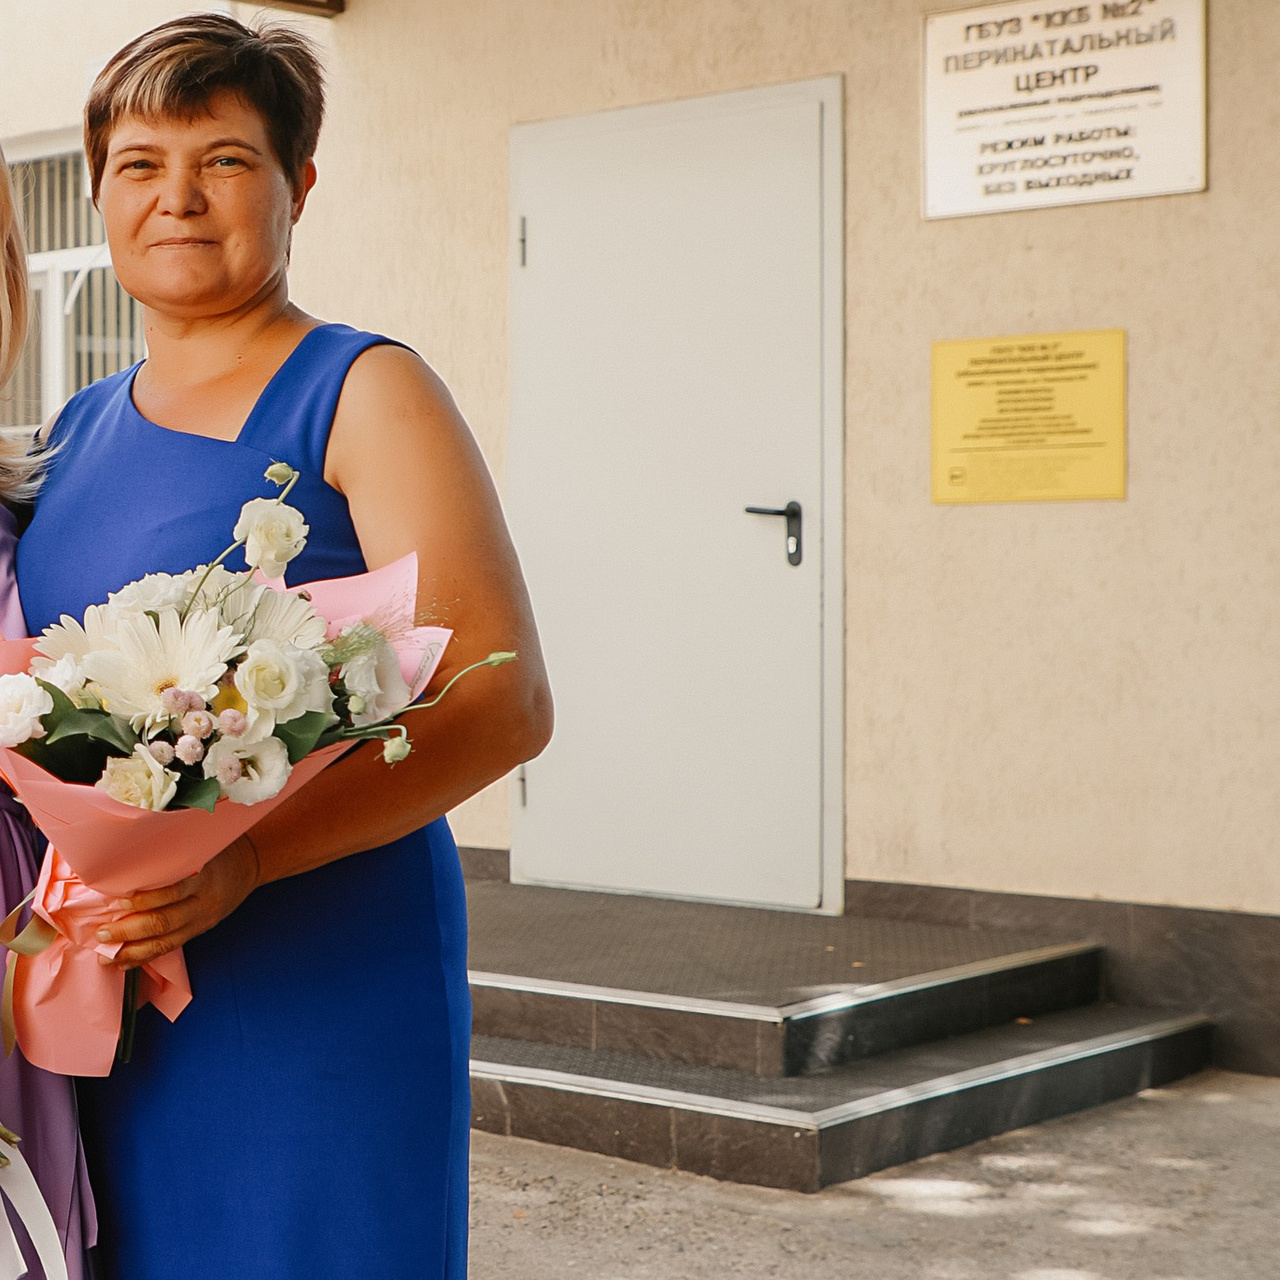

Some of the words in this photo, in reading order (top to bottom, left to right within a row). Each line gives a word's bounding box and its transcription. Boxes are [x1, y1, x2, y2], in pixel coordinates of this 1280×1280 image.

[965, 17, 1021, 42] ГБУЗ
[944, 17, 1177, 73] ПЕРИНАТАЛЬНЫЙ
[1015, 64, 1099, 93] ЦЕНТР
[980, 136, 1045, 154] РЕЖИМ
[1025, 168, 1133, 190] ВЫХОДНЫХ
